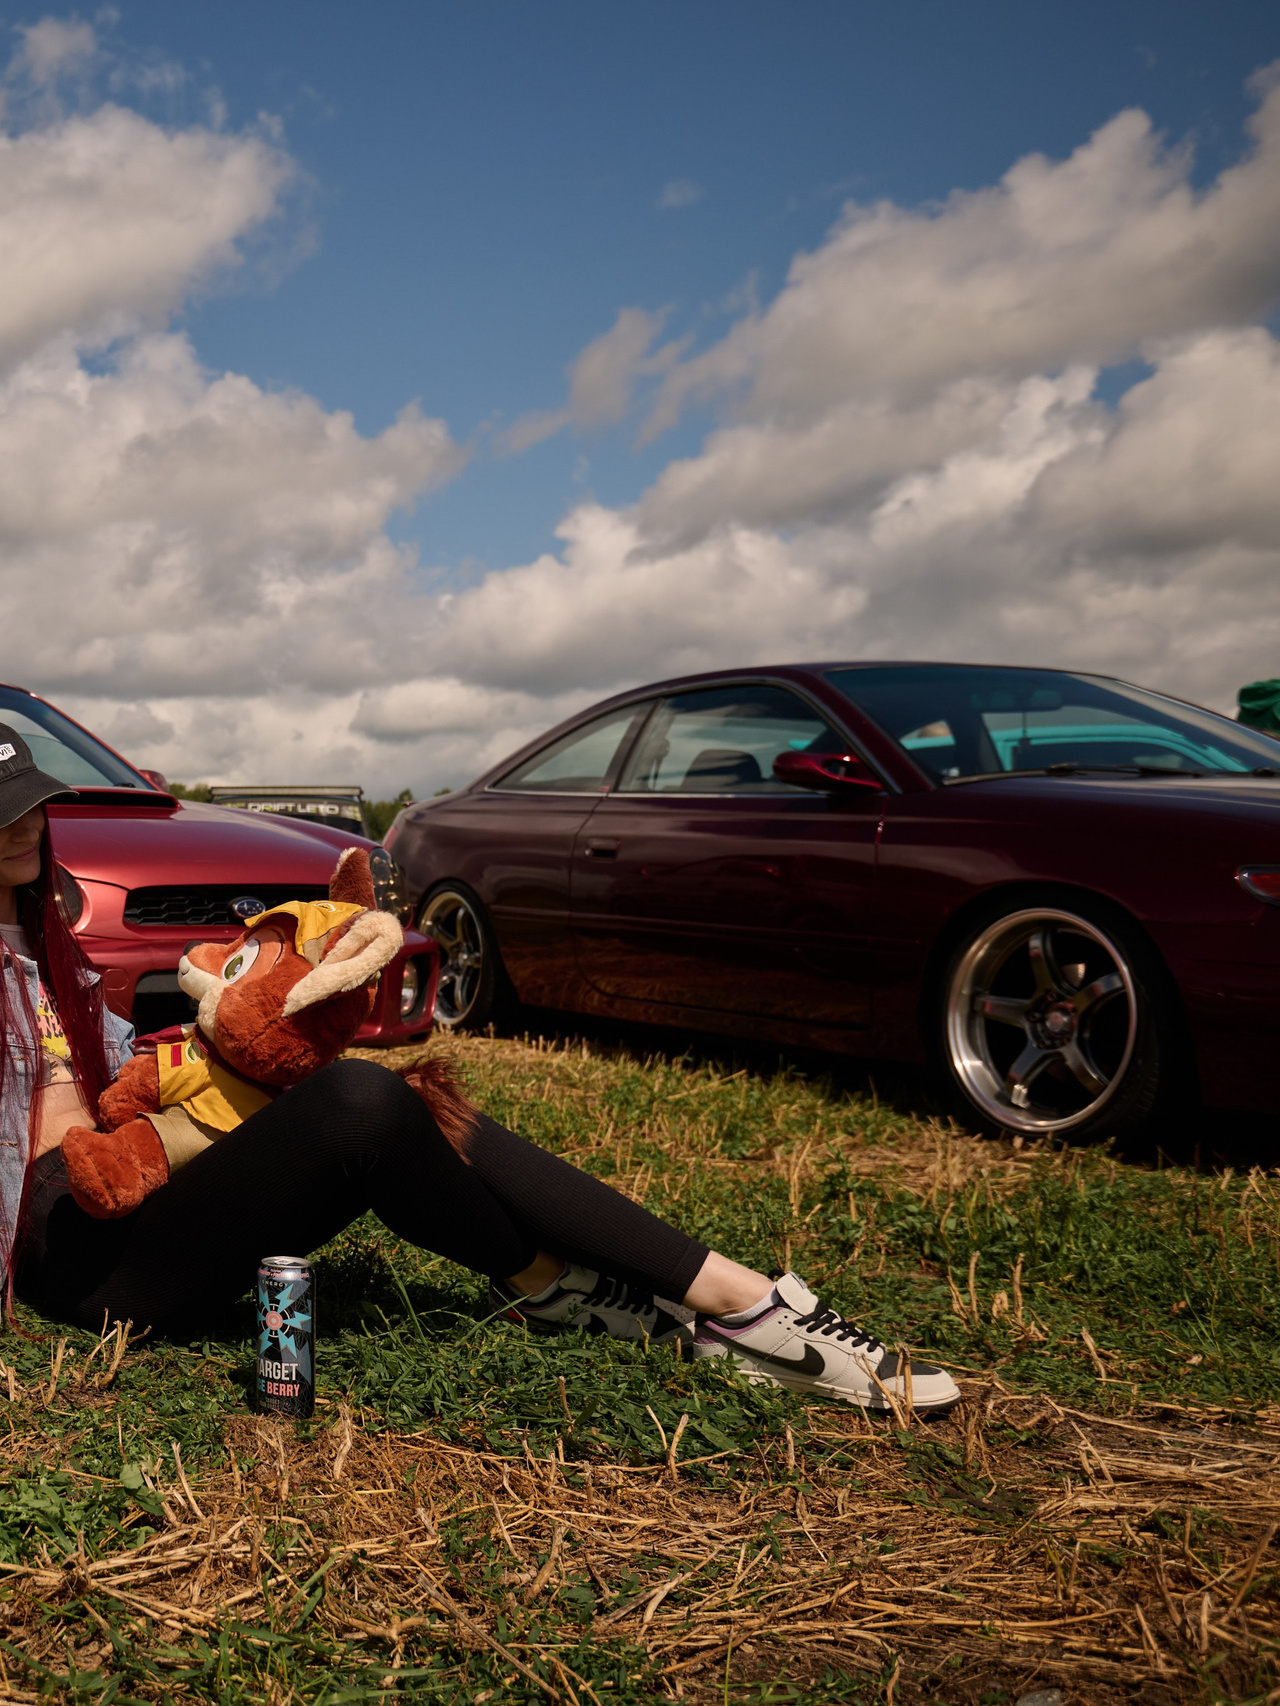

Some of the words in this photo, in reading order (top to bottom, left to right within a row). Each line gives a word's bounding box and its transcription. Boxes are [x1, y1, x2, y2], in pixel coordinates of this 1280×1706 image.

[247, 802, 296, 813] DRIFT
[257, 1377, 266, 1393] CE
[266, 1380, 300, 1398] BERRY
